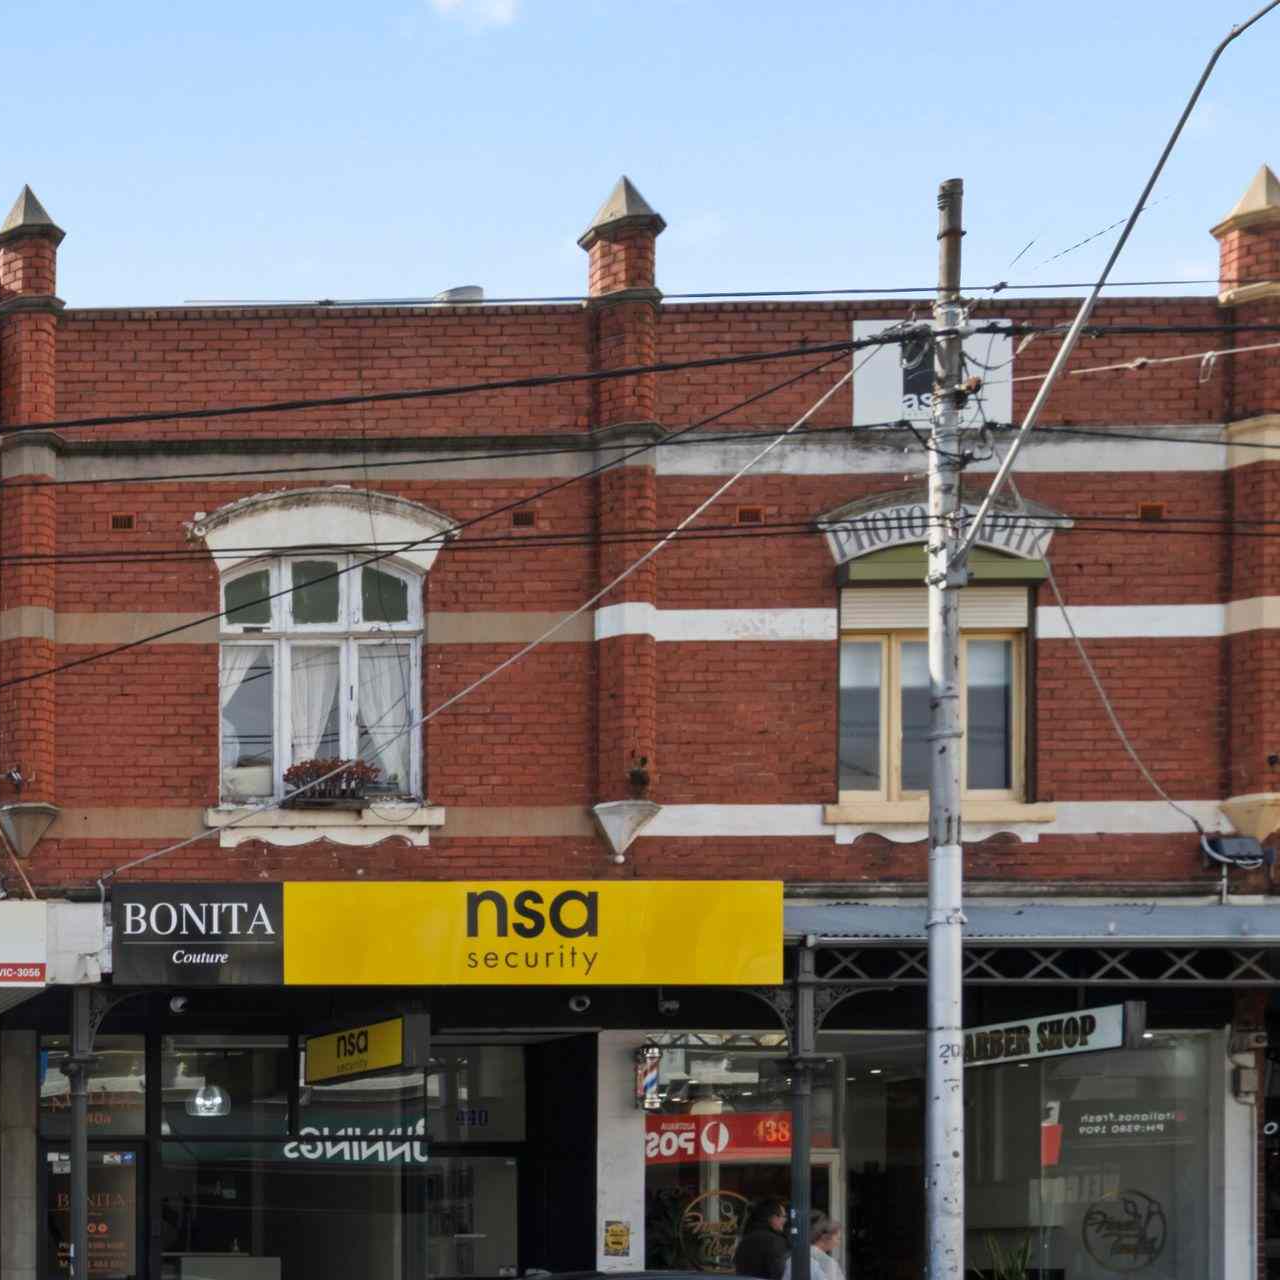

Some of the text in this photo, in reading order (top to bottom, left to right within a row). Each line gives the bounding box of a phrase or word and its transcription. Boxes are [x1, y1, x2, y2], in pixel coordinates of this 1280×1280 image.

[123, 902, 275, 936] BONITA
[466, 889, 599, 938] nsa
[172, 949, 229, 965] Couture
[467, 944, 599, 975] security
[336, 1030, 369, 1058] nsa
[964, 1014, 1097, 1060] ARBER SHOP
